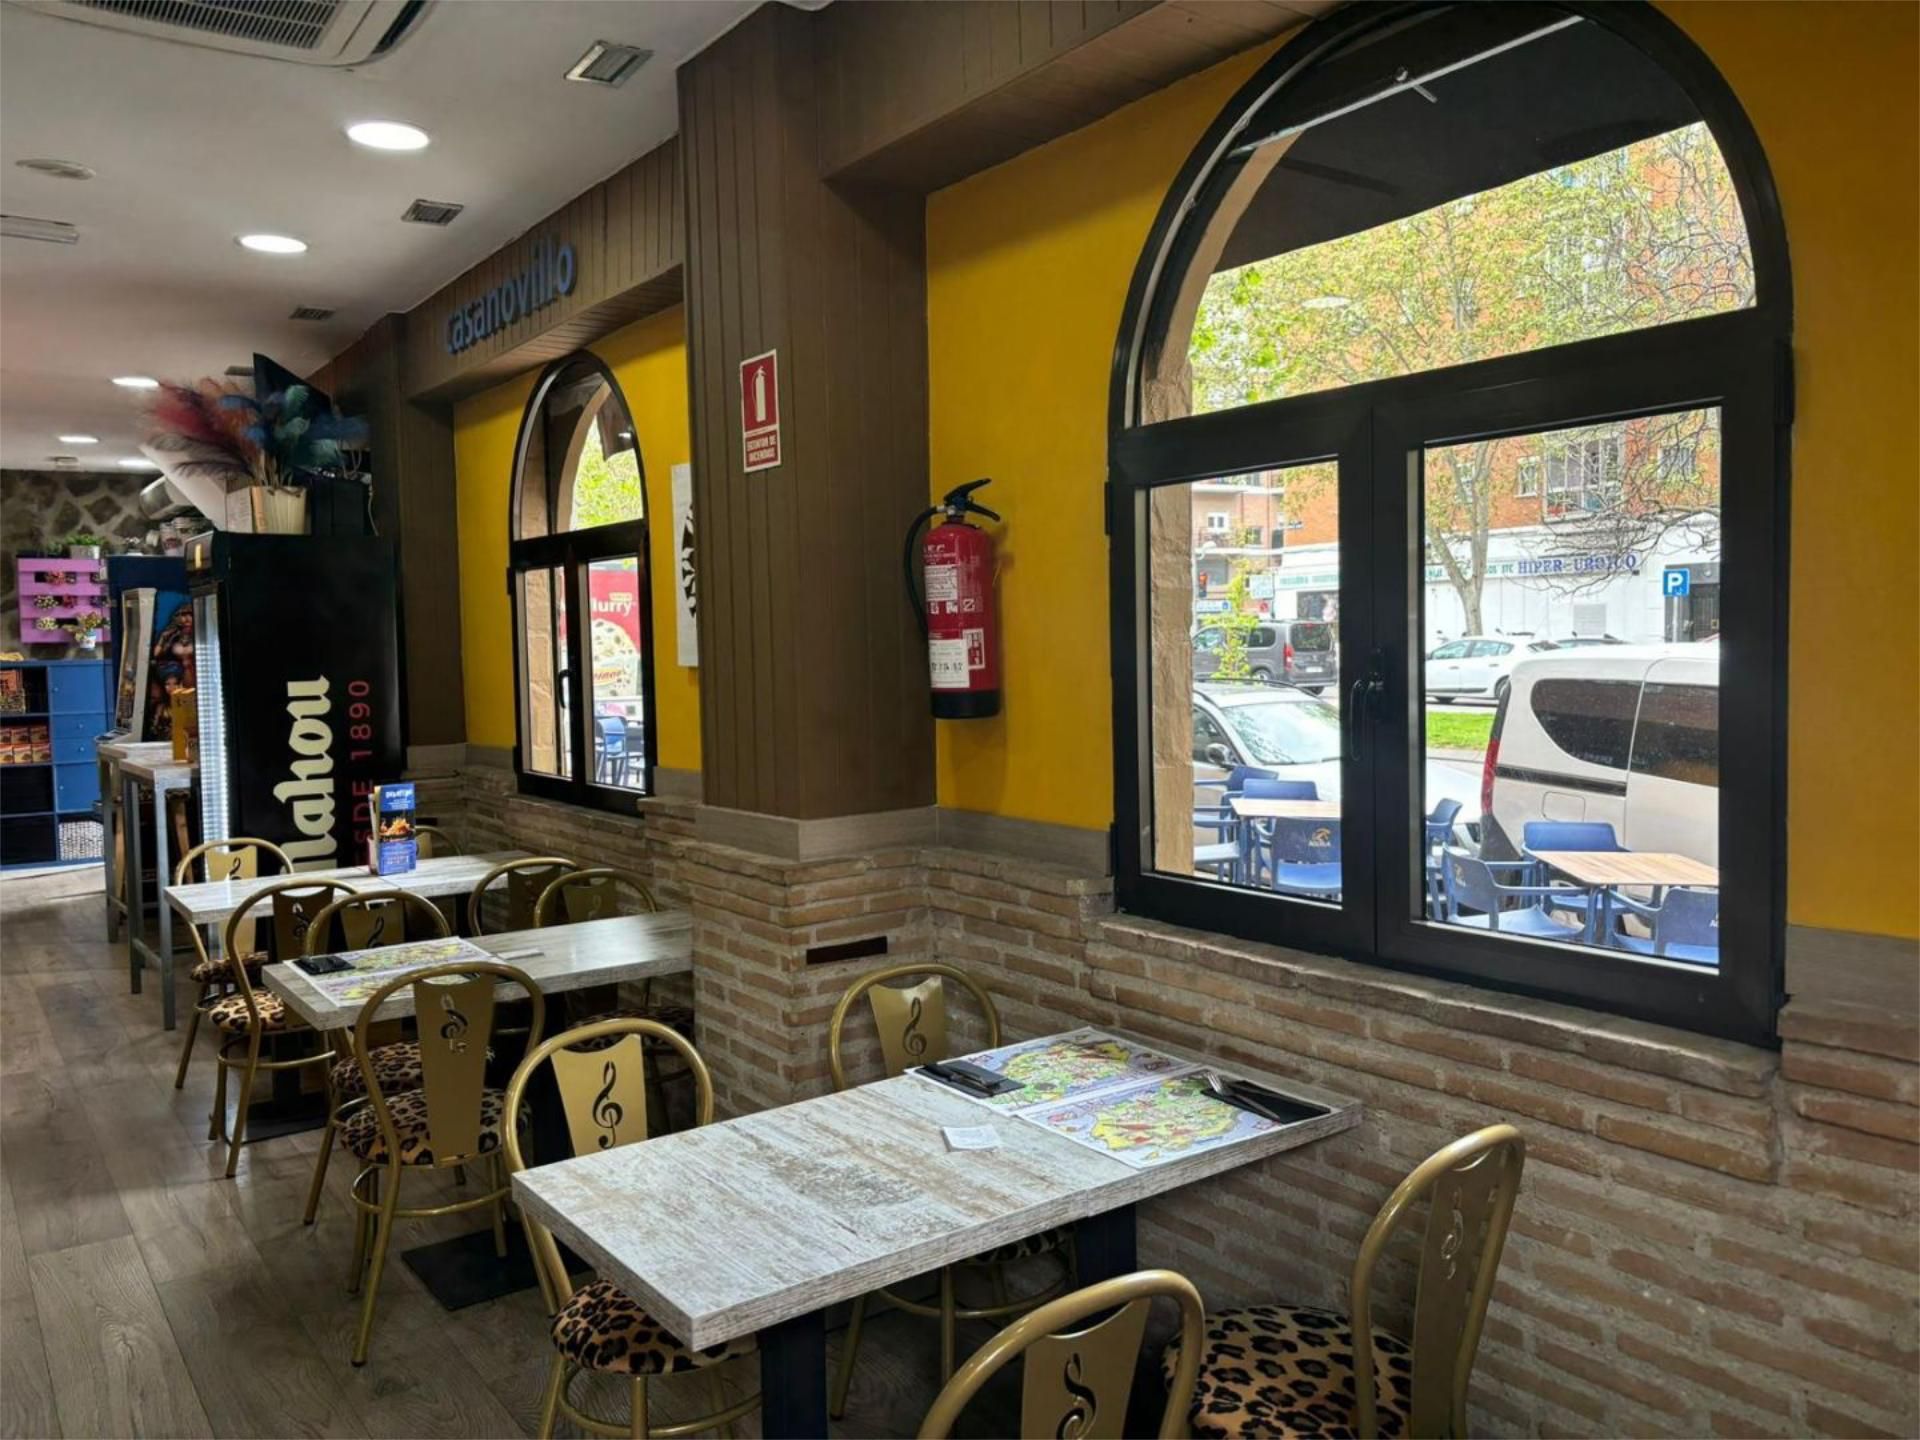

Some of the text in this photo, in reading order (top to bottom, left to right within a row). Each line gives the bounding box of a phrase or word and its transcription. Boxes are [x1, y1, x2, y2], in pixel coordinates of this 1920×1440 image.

[1518, 559, 1563, 574] HIPER
[1667, 573, 1684, 593] P
[348, 680, 372, 761] 1890
